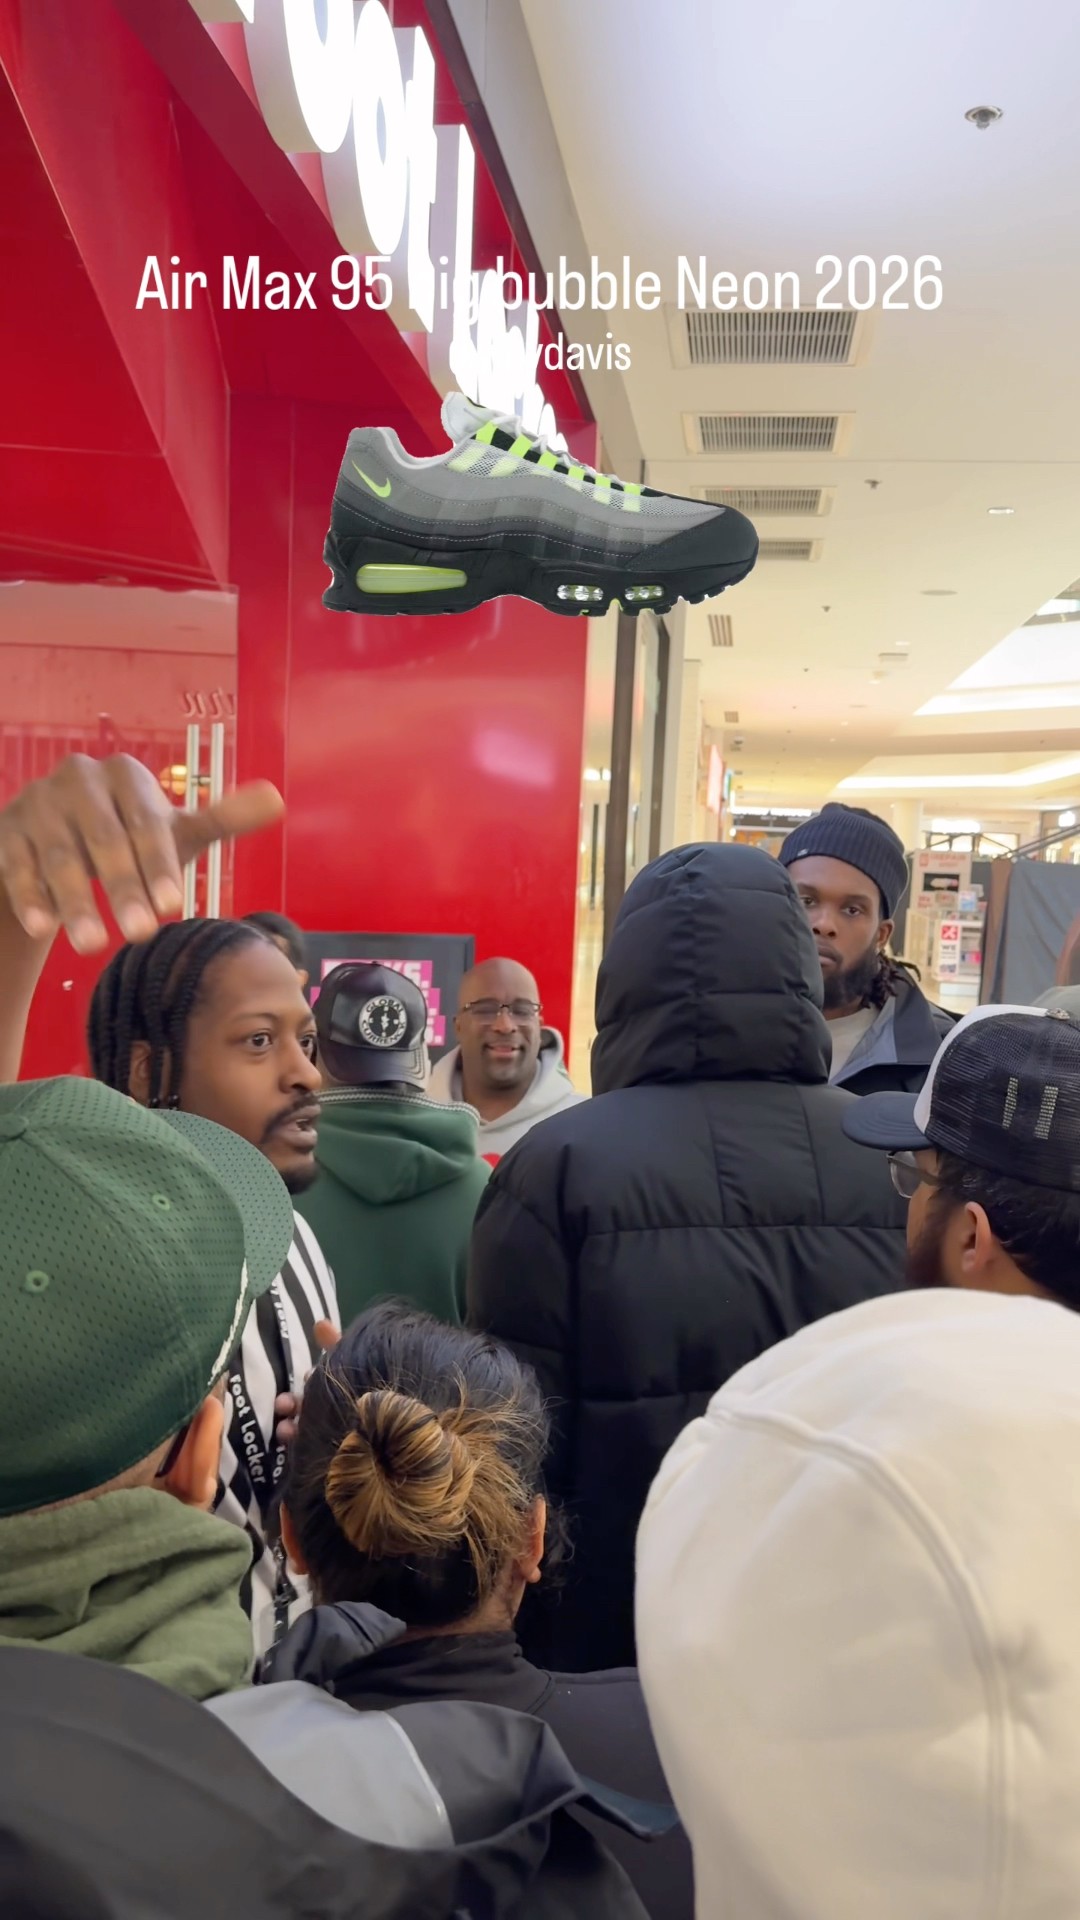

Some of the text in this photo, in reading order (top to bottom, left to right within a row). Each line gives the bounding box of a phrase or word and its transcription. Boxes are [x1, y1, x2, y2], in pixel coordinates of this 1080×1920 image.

[366, 998, 404, 1013] GLOBAL
[362, 1019, 406, 1045] CURRENCY
[230, 1374, 266, 1483] Foot Locker
